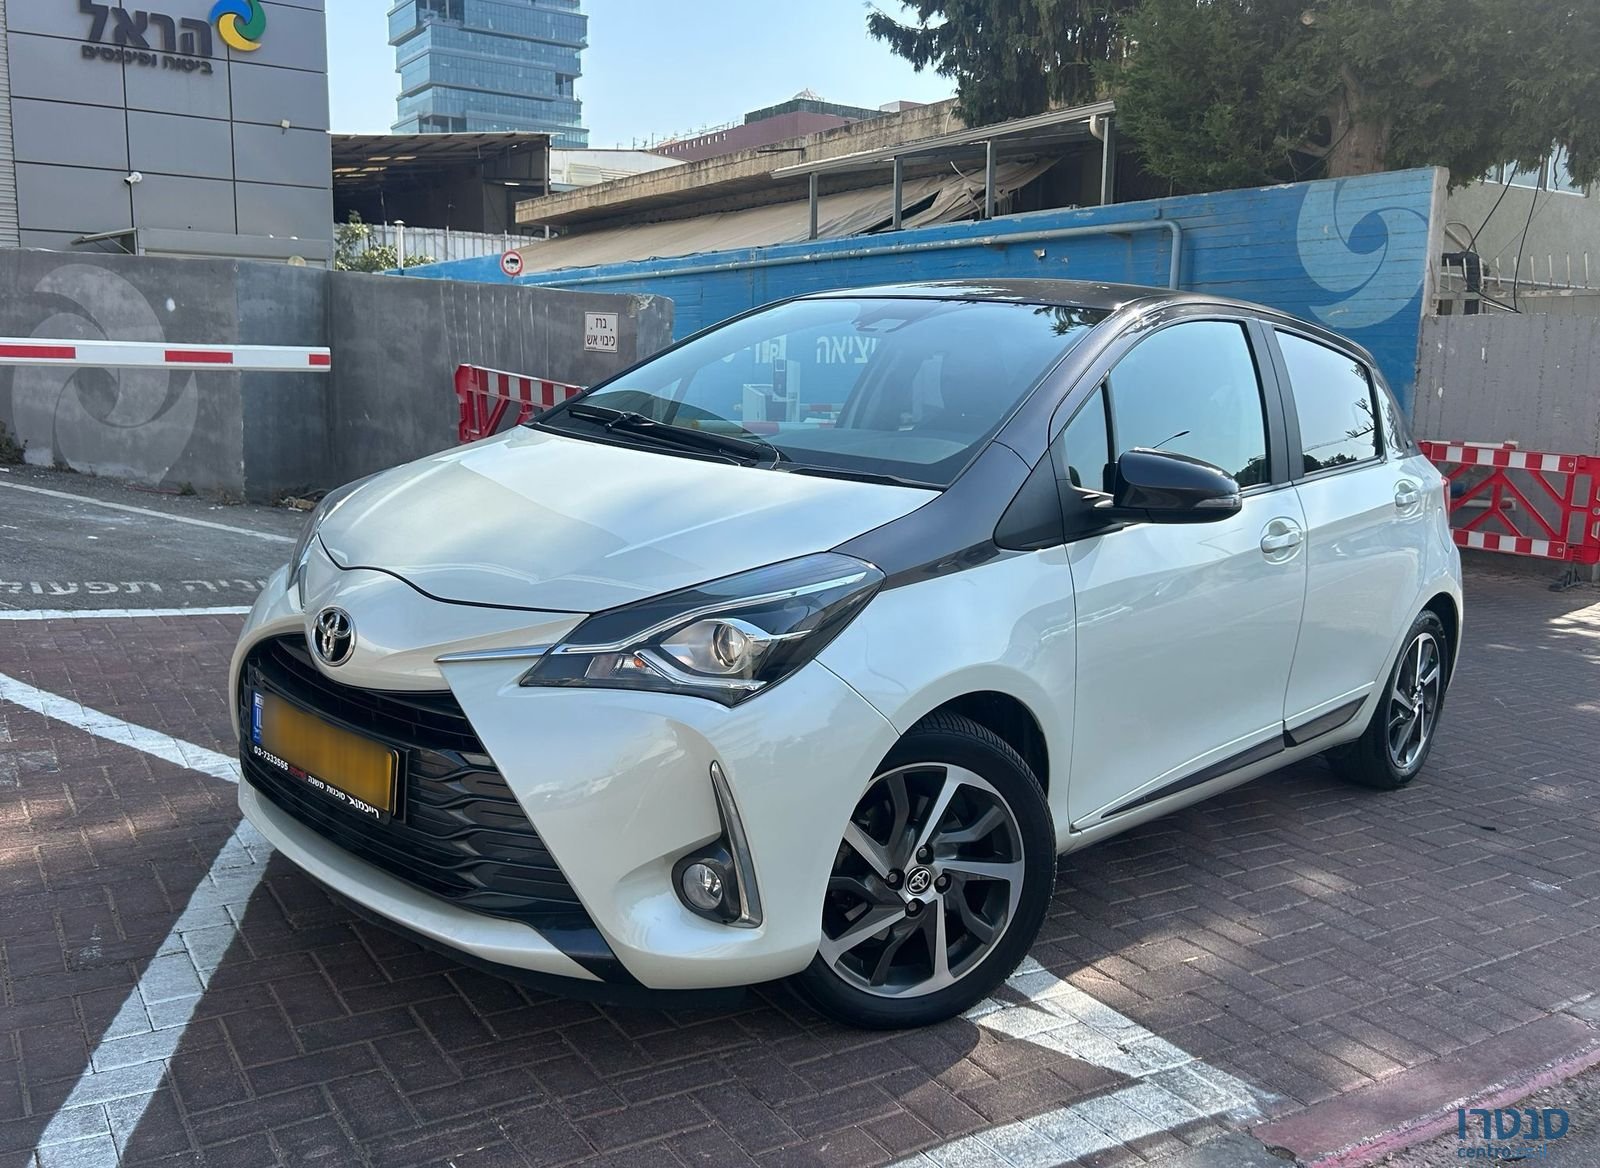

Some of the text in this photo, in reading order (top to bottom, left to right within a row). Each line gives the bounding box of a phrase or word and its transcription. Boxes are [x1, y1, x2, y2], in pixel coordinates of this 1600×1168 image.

[80, 0, 212, 57] הראל
[81, 45, 213, 74] ביטוח ופיננסים
[595, 318, 607, 329] ברז
[586, 335, 616, 346] כיבוי אש
